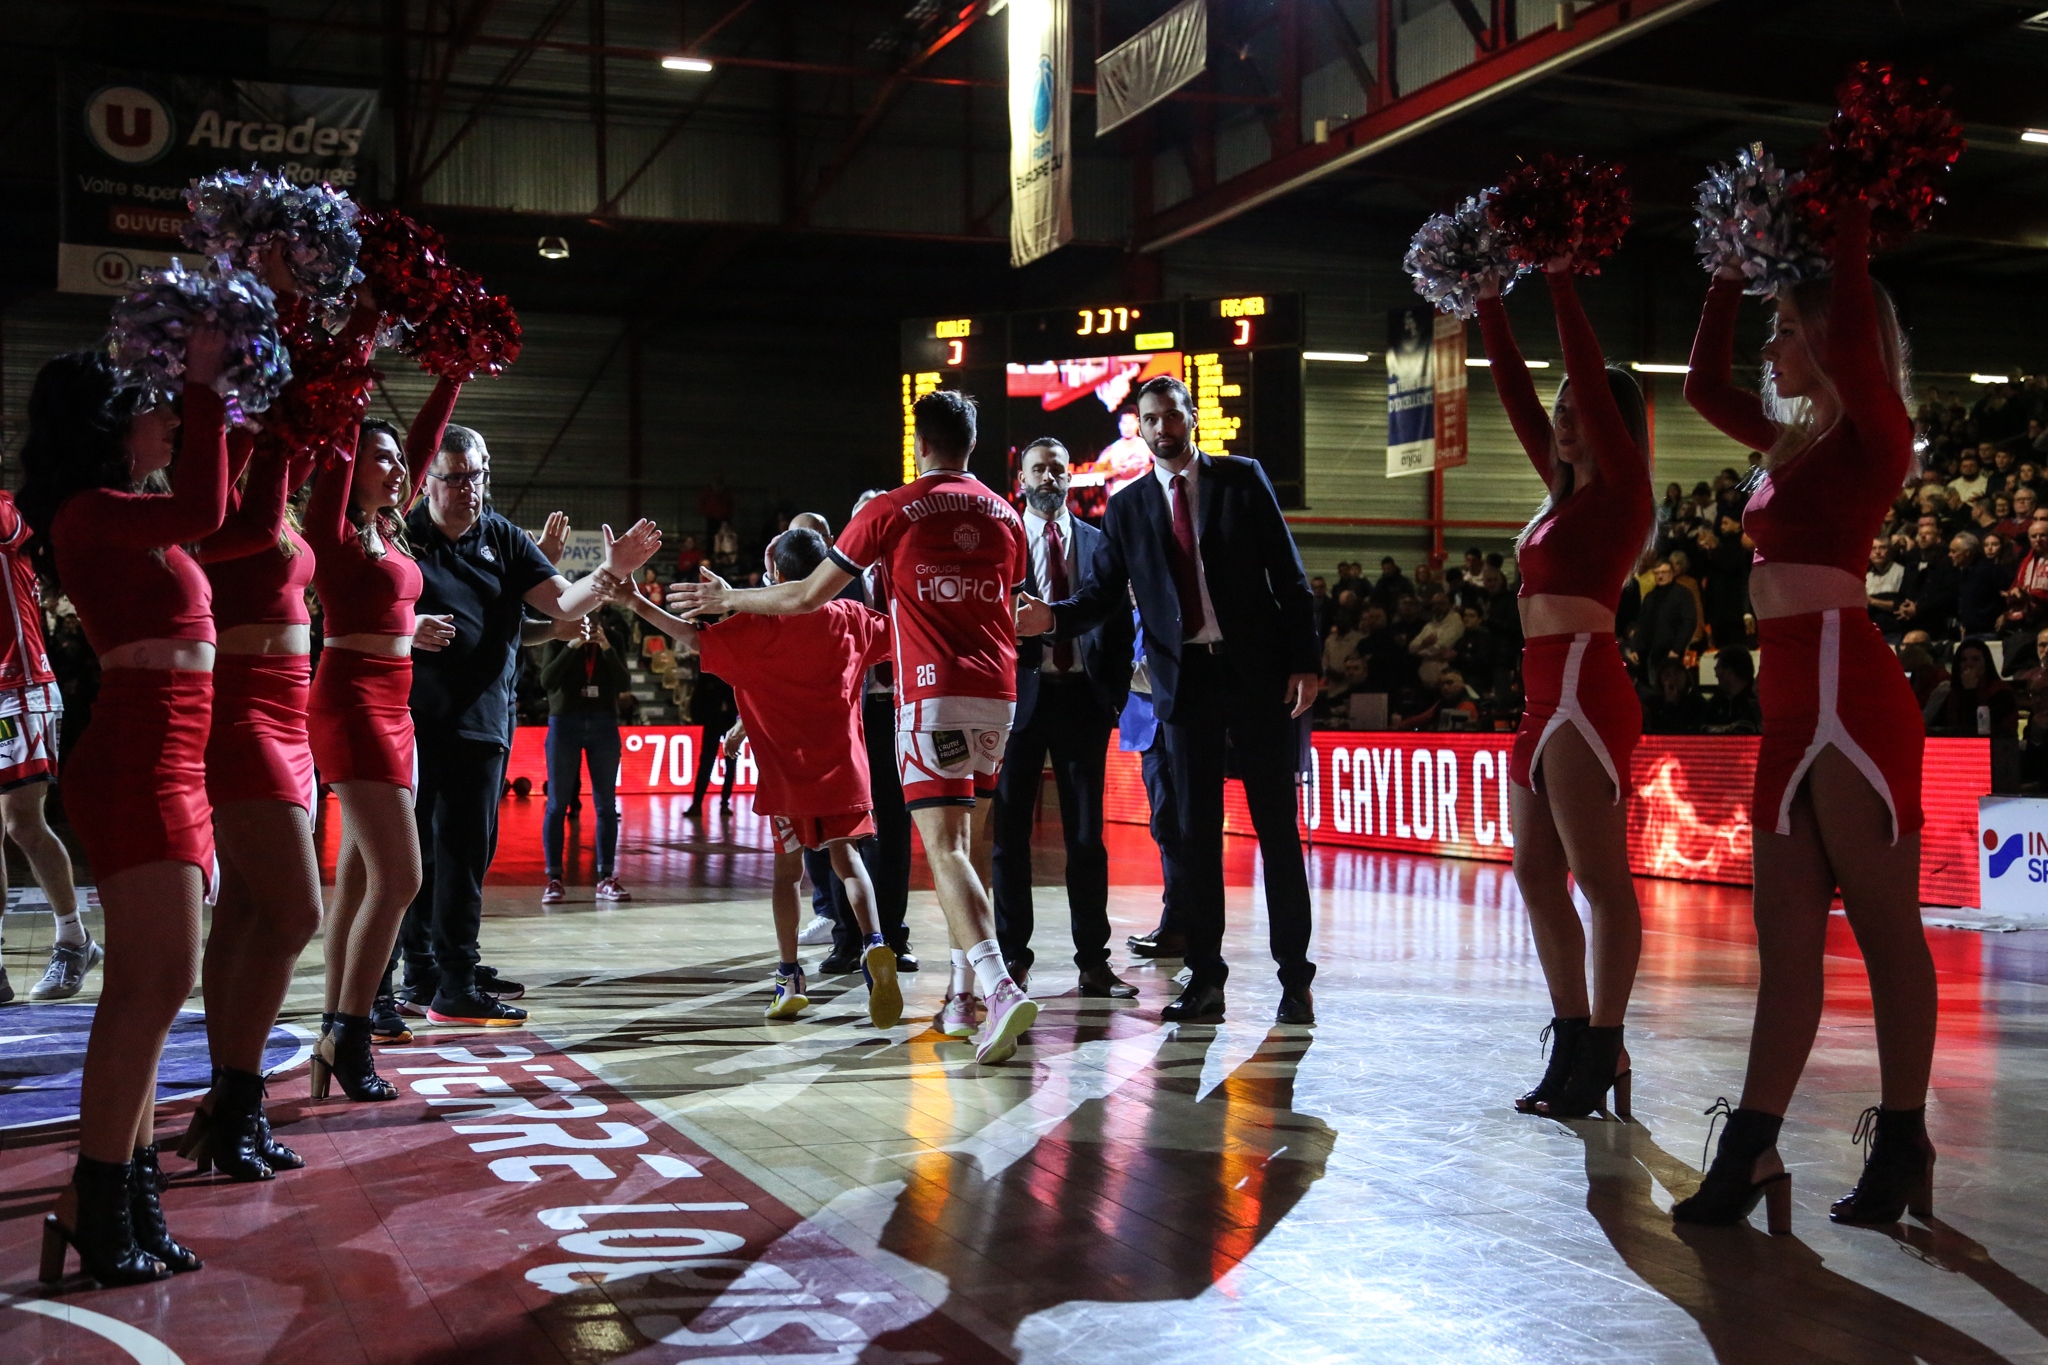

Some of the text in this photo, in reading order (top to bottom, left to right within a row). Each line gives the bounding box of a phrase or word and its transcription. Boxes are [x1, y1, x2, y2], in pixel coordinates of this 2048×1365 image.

[106, 103, 152, 148] U
[187, 109, 364, 157] Arcades
[78, 174, 128, 197] Votre
[115, 213, 190, 235] OUVER
[953, 531, 981, 544] CHOLET
[562, 546, 602, 560] PAYS
[915, 563, 961, 576] Groupe
[916, 664, 937, 687] 26
[938, 740, 960, 752] L'AUTRE
[940, 745, 967, 759] FAUBOURG
[1331, 747, 1459, 843] GAYLOR
